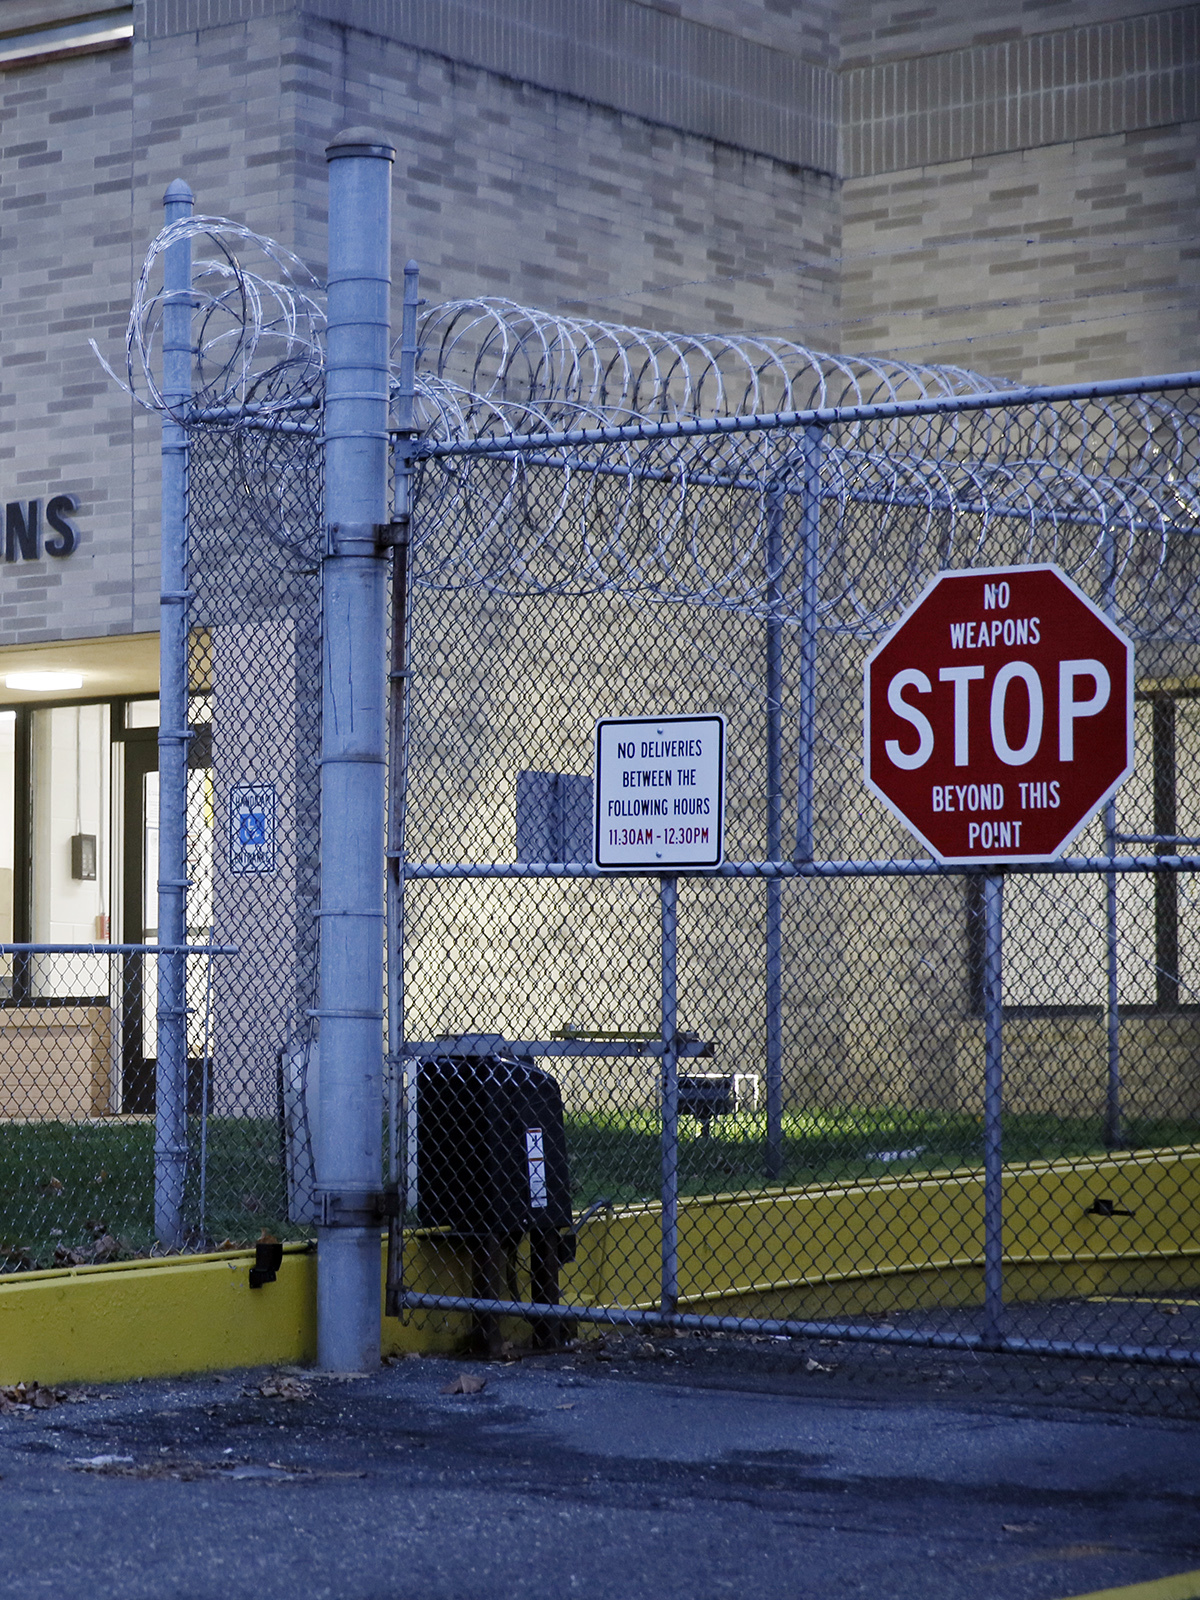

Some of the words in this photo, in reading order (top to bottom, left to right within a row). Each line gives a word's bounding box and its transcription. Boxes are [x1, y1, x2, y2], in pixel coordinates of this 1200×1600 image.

[984, 582, 1010, 610] NO
[950, 617, 1041, 649] WEAPONS
[885, 659, 1111, 770] STOP
[617, 743, 636, 759] NO
[641, 741, 702, 758] DELIVERIES
[623, 771, 672, 787] BETWEEN
[678, 769, 696, 786] THE
[608, 800, 668, 816] FOLLOWING
[674, 798, 710, 815] HOURS
[933, 784, 1004, 812] BEYOND
[1019, 781, 1061, 809] THIS
[609, 829, 653, 845] 11:30AM
[664, 827, 709, 844] 12:30PM
[969, 822, 1022, 849] POINT
